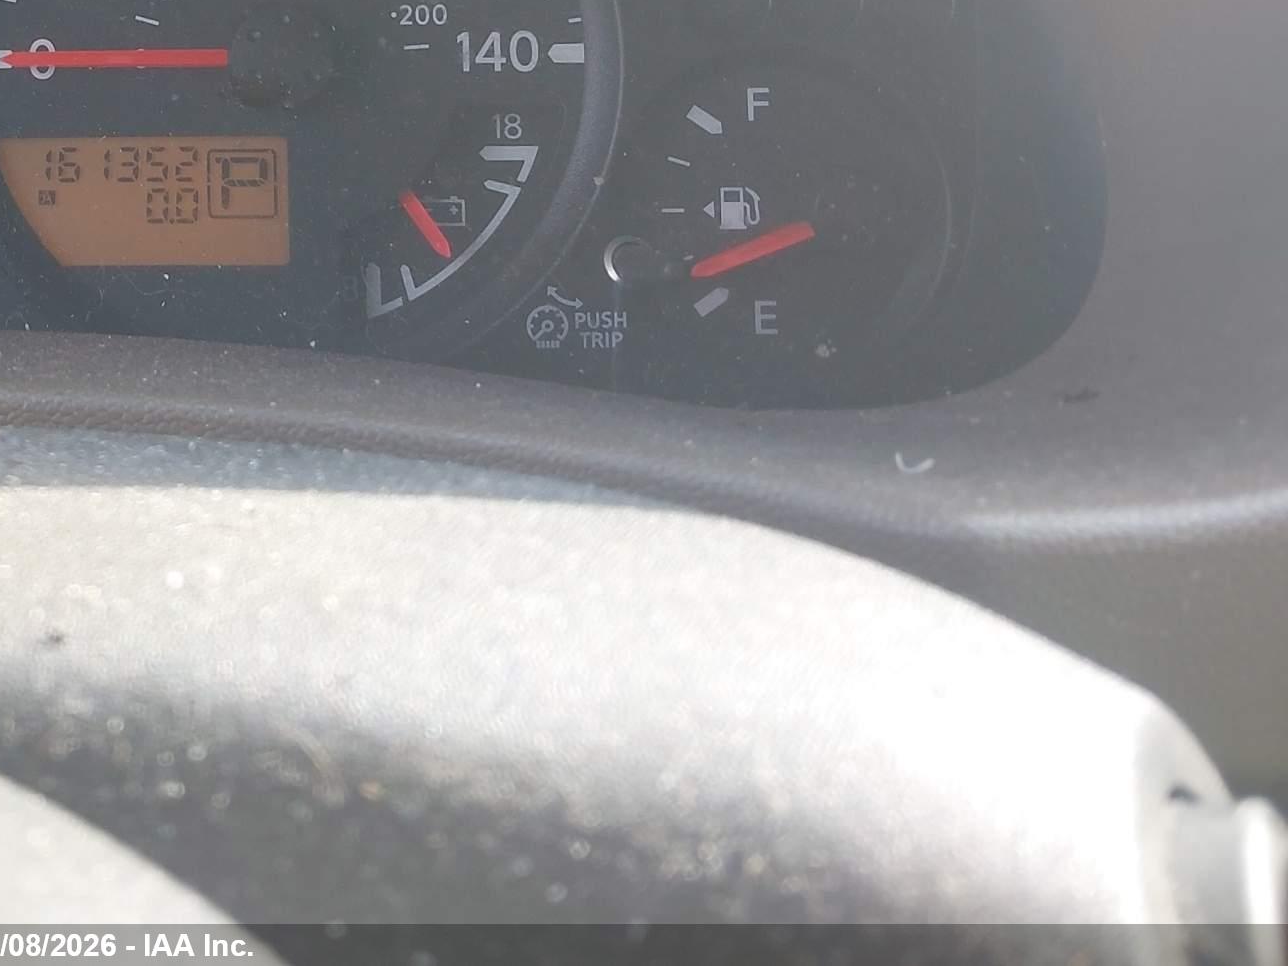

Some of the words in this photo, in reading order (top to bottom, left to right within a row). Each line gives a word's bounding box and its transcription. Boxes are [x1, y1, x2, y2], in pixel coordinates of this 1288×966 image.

[399, 4, 448, 25] 200
[457, 30, 539, 72] 140
[747, 87, 771, 122] F
[492, 113, 523, 139] 18
[45, 146, 199, 183] 161352
[215, 156, 269, 210] P
[146, 188, 199, 224] 0.0
[574, 311, 627, 329] PUSH
[754, 301, 779, 335] E
[580, 332, 624, 349] TRIP
